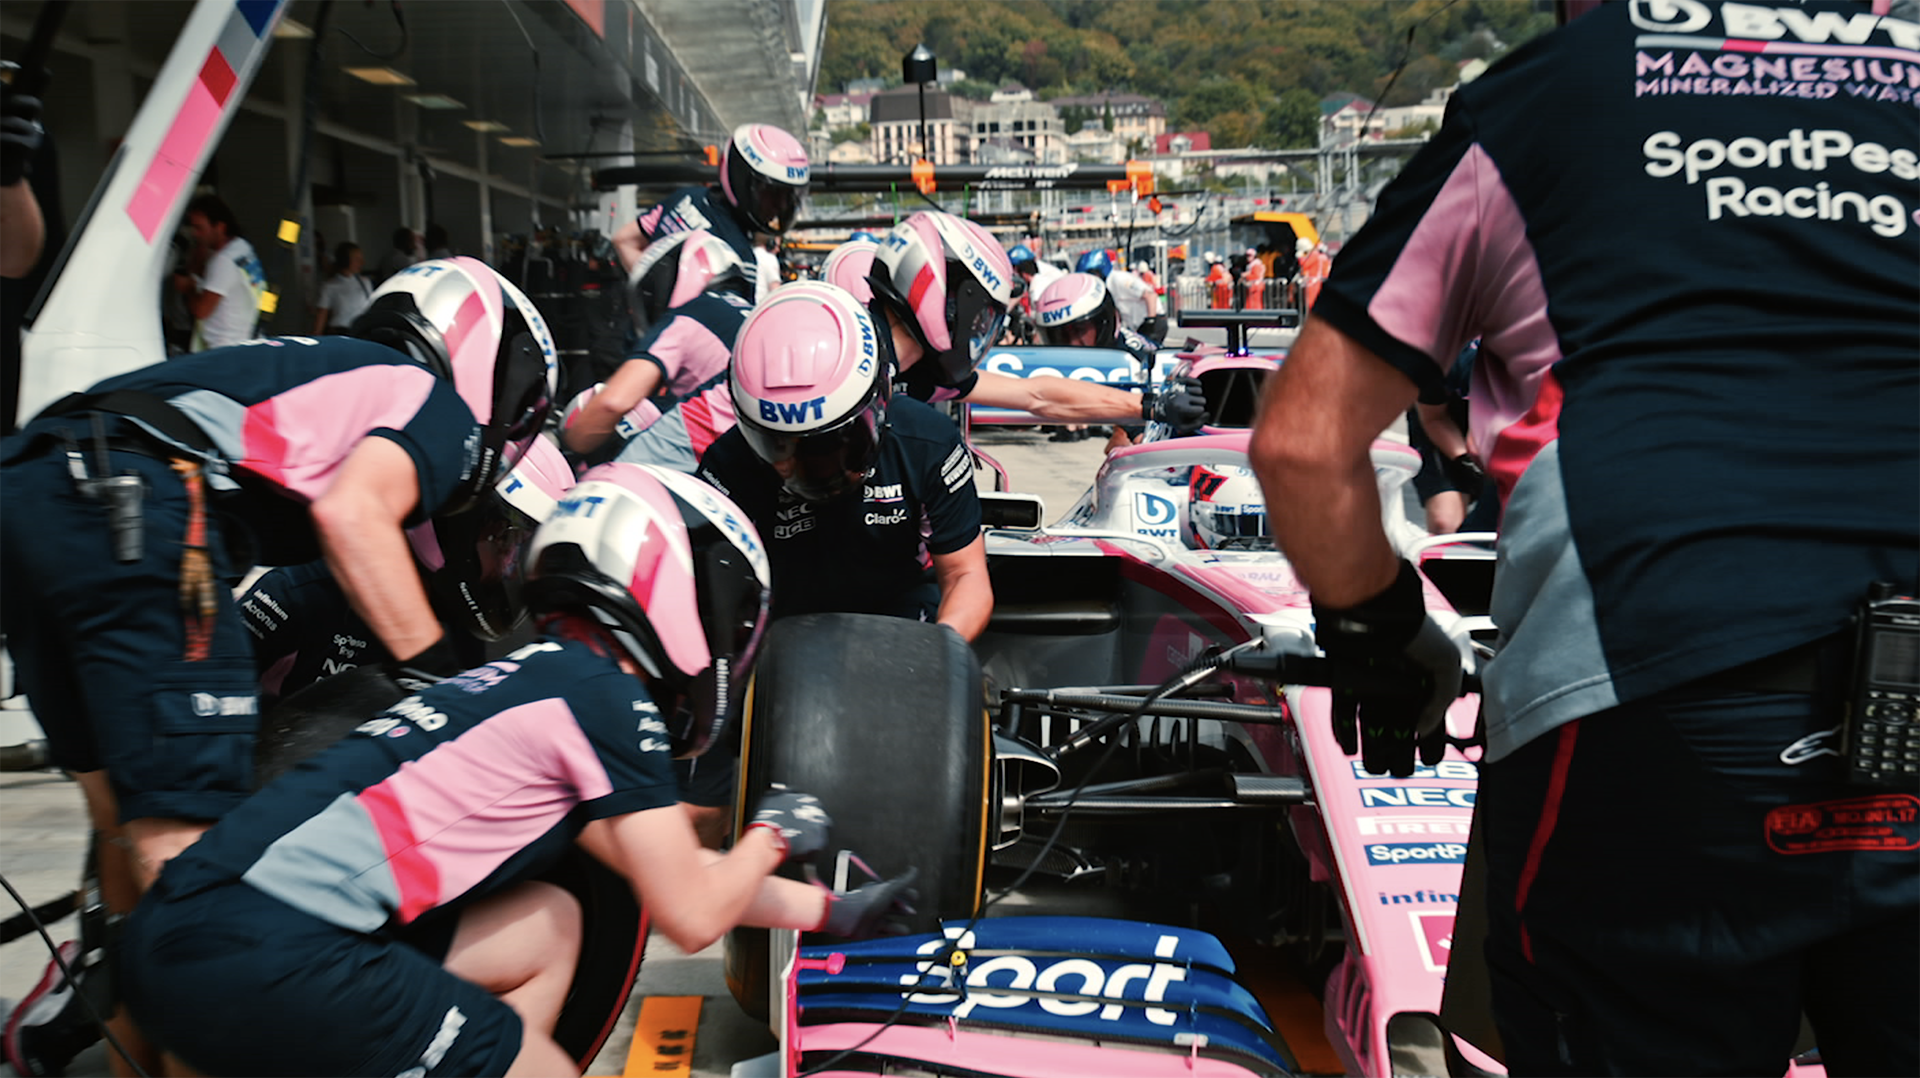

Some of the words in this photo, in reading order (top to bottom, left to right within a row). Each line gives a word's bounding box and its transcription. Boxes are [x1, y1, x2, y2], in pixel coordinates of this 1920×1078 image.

[1720, 2, 1920, 50] BWT
[1635, 77, 1838, 98] MINERALIZED
[1643, 128, 1920, 184] SportPes
[1706, 176, 1907, 237] Racing
[973, 257, 1001, 291] BWT
[1042, 305, 1072, 323] BWT
[855, 311, 875, 358] BWT
[758, 396, 826, 424] BWT
[873, 483, 903, 499] BWT
[775, 517, 813, 538] JCB
[864, 509, 907, 525] Claro
[241, 599, 279, 632] Acronis
[1360, 786, 1478, 807] NEC
[900, 927, 1187, 1027] Sport
